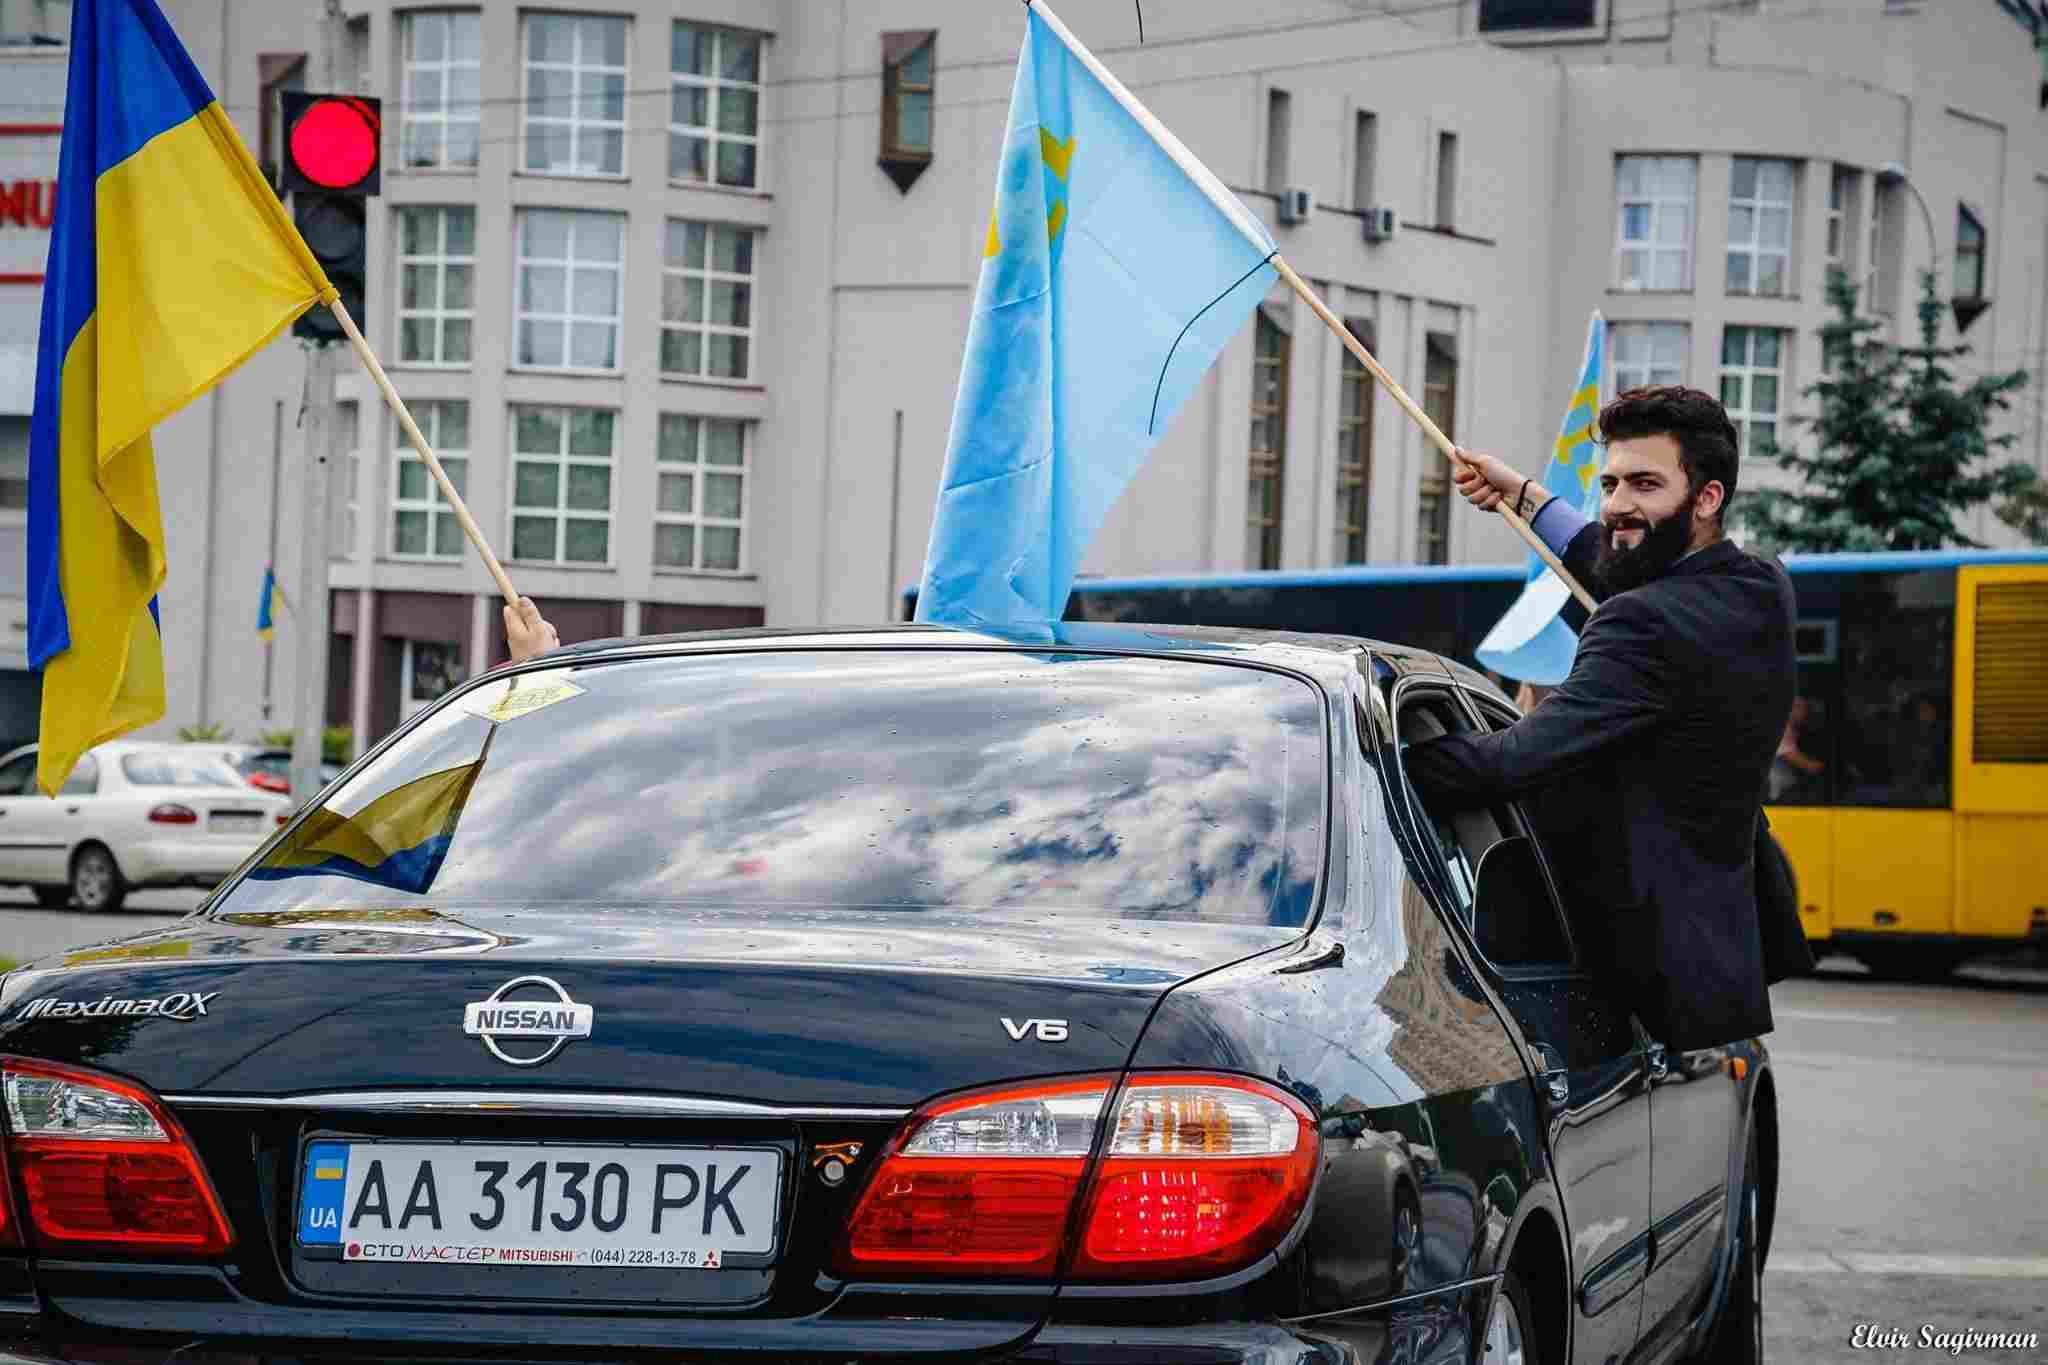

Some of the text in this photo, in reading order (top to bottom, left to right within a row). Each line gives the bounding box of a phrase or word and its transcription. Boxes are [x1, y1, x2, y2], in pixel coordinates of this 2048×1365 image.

[477, 1010, 575, 1029] NISSAN
[1000, 1017, 1068, 1041] V6
[349, 1160, 751, 1235] AA 3130 PK
[310, 1207, 337, 1228] UA
[499, 1249, 574, 1263] MITSUBISHI
[591, 1248, 625, 1264] (044)
[628, 1250, 696, 1264] 228-13-78
